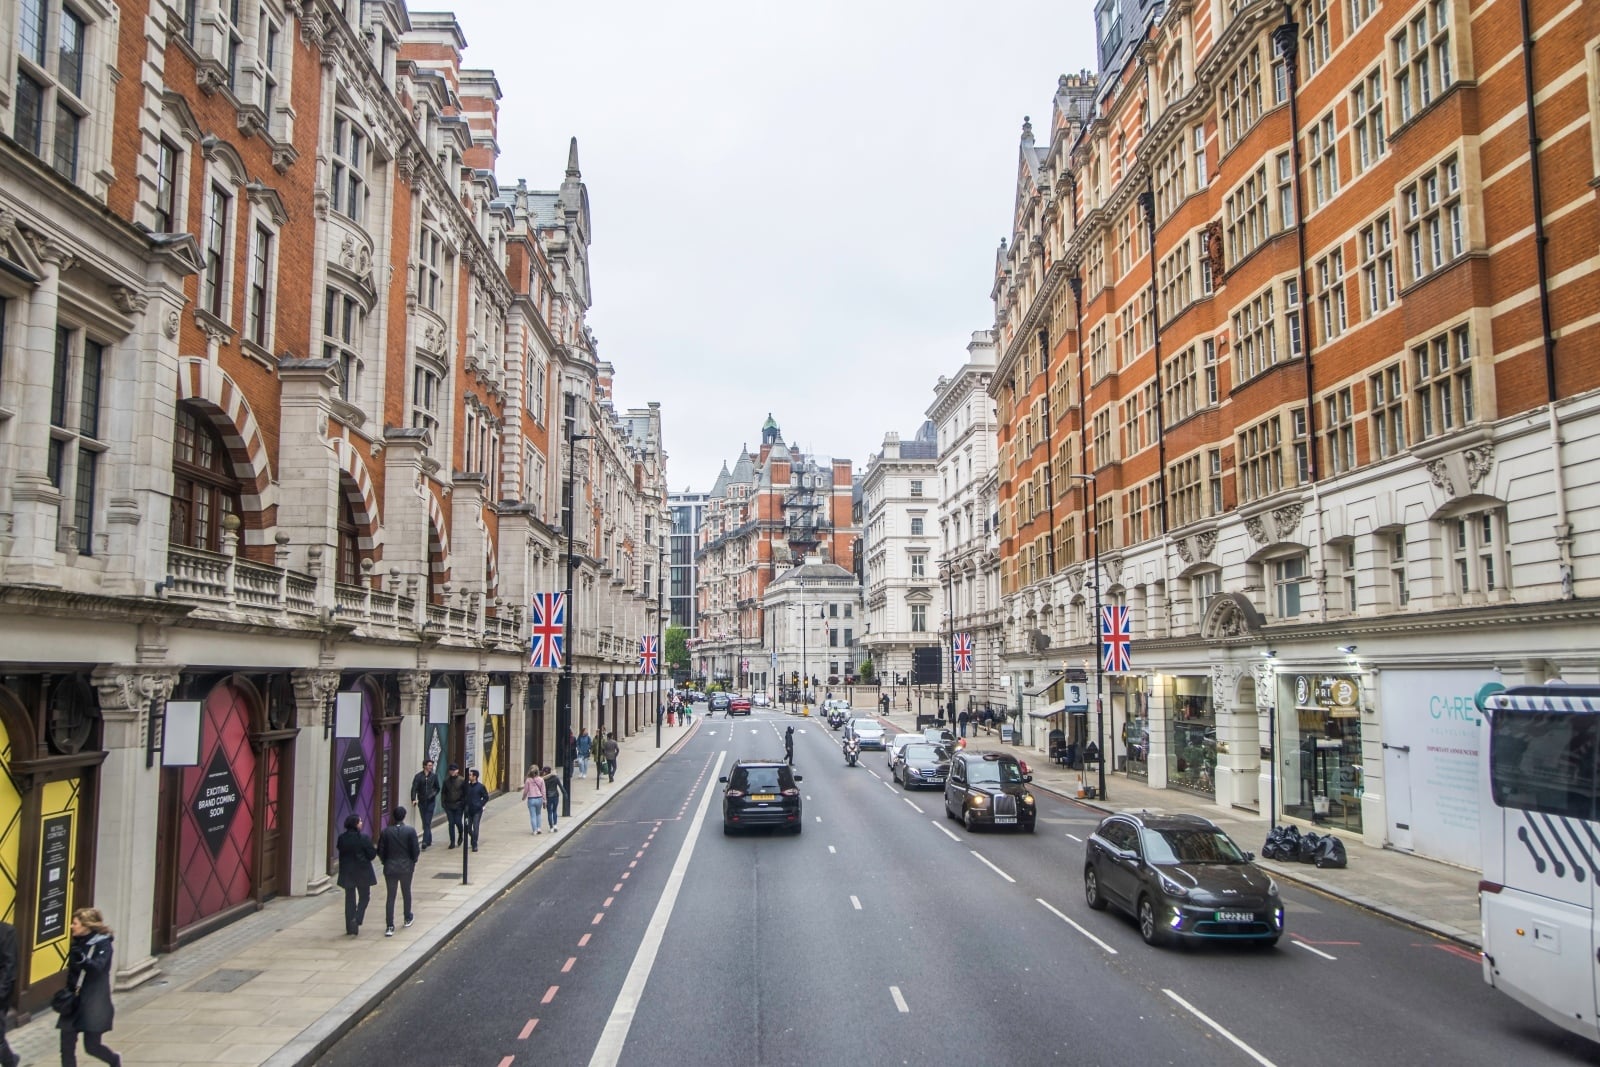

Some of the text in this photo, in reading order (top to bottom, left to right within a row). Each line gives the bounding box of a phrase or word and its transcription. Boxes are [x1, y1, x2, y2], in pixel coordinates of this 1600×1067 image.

[206, 785, 229, 797] EXCITING
[198, 794, 236, 810] BRAND COMING
[209, 807, 225, 818] SOON
